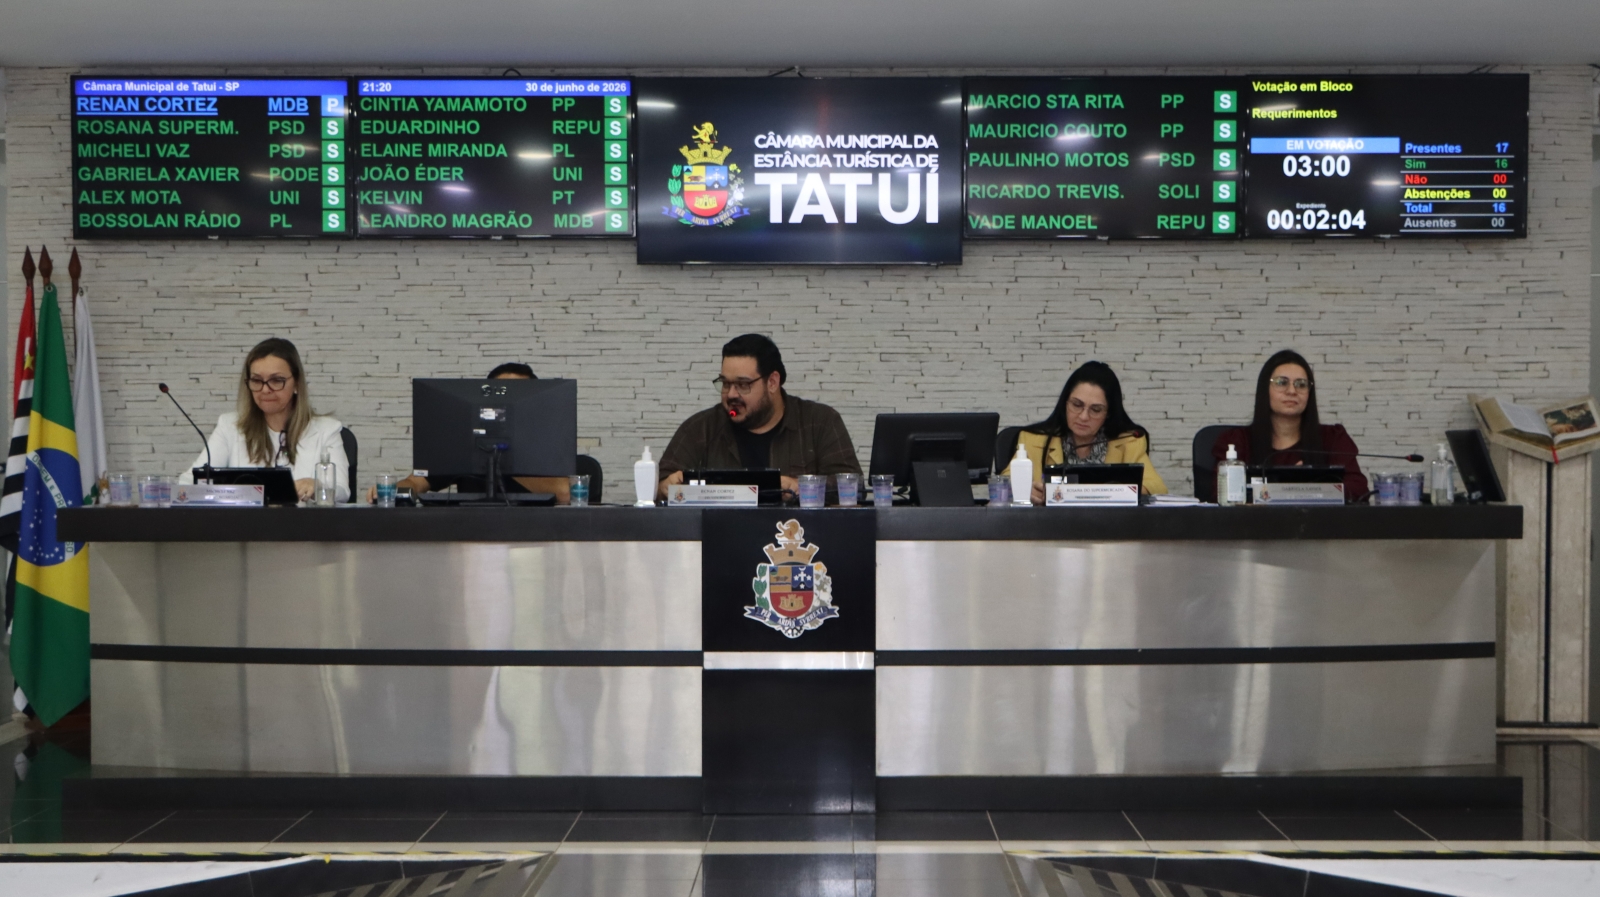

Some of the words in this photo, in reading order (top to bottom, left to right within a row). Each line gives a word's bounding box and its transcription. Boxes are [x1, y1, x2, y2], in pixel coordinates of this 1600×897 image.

[83, 81, 122, 91] Câmara
[125, 82, 174, 93] Municipal
[176, 82, 189, 91] de
[225, 82, 240, 91] SP
[363, 83, 392, 92] 21:20
[525, 83, 538, 92] 30
[540, 83, 553, 92] de
[555, 83, 585, 93] junho
[587, 83, 600, 92] de
[602, 83, 626, 92] 2026
[1253, 81, 1297, 93] Votação
[1320, 81, 1353, 91] Bloco
[77, 97, 139, 111] RENAN
[145, 97, 217, 111] CORTEZ
[268, 98, 308, 111] MDB
[328, 99, 338, 110] P
[360, 97, 419, 111] CINTIA
[424, 97, 527, 111] YAMAMOTO
[552, 98, 575, 111] PP
[610, 98, 621, 113] S
[970, 95, 1040, 109] MARCIO
[1046, 95, 1079, 109] STA
[1085, 95, 1124, 109] RITA
[1161, 95, 1184, 108] PP
[1219, 94, 1231, 109] S
[1252, 109, 1337, 120] Requerimentos
[78, 120, 153, 134] ROSANA
[158, 120, 239, 134] SUPERM.
[269, 120, 305, 134] PSD
[327, 121, 338, 135] S
[360, 120, 480, 134] EDUARDINHO
[553, 121, 600, 134] REPU
[610, 121, 621, 136] S
[969, 124, 1058, 138] MAURICIO
[1064, 124, 1127, 138] COUTO
[1161, 124, 1183, 138] PP
[1219, 123, 1231, 138] S
[754, 132, 823, 149] CÂMARA
[827, 135, 913, 149] MUNICIPAL
[914, 135, 938, 148] DA
[1287, 140, 1305, 150] EM
[1307, 138, 1364, 151] VOTAÇÃO
[78, 144, 150, 158] MICHELI
[156, 144, 190, 158] VAZ
[269, 144, 305, 158] PSD
[327, 144, 339, 158] S
[360, 144, 422, 158] ELAINE
[428, 144, 508, 158] MIRANDA
[553, 144, 574, 157] PL
[610, 143, 621, 158] S
[1405, 143, 1461, 155] Presentes
[1496, 143, 1509, 153] 17
[754, 151, 832, 168] ESTÂNCIA
[834, 151, 914, 168] TURÍSTICA
[918, 154, 938, 167] DE
[969, 153, 1059, 167] PAULINHO
[1065, 153, 1129, 167] MOTOS
[1159, 153, 1195, 167] PSD
[1219, 152, 1230, 167] S
[1283, 155, 1351, 177] 03:00
[1405, 159, 1426, 169] Sim
[1496, 159, 1508, 168] 16
[78, 167, 170, 181] GABRIELA
[175, 167, 240, 181] XAVIER
[269, 168, 319, 181] PODE
[328, 167, 339, 182] S
[360, 164, 409, 181] JOÃO
[415, 163, 464, 181] ÉDER
[553, 167, 582, 181] UNI
[610, 167, 622, 182] S
[1405, 174, 1427, 184] Não
[1493, 174, 1507, 184] 00
[79, 191, 124, 205] ALEX
[131, 191, 181, 205] MOTA
[270, 191, 299, 205] UNI
[328, 190, 339, 205] S
[360, 191, 422, 205] KELVIN
[553, 191, 574, 204] PT
[610, 190, 622, 205] S
[754, 168, 939, 224] TATUÍ
[969, 184, 1051, 199] RICARDO
[1057, 184, 1124, 199] TREVIS.
[1158, 184, 1199, 199] SOLI
[1219, 184, 1230, 199] S
[1404, 188, 1470, 201] Abstenções
[1493, 189, 1506, 199] 00
[1405, 204, 1432, 213] Total
[1492, 204, 1506, 213] 16
[79, 214, 178, 228] BOSSOLAN
[184, 210, 241, 228] RÁDIO
[270, 215, 292, 228] PL
[328, 214, 339, 229] S
[360, 214, 446, 228] LEANDRO
[452, 210, 532, 228] MAGRÃO
[554, 214, 593, 228] MDB
[610, 214, 622, 229] S
[969, 215, 1015, 229] VADE
[1022, 215, 1097, 229] MANOEL
[1157, 215, 1205, 229] REPU
[1218, 215, 1230, 230] S
[1267, 210, 1366, 230] 00:02:04
[1404, 218, 1456, 228] Ausentes
[1491, 218, 1505, 228] 00
[760, 608, 772, 619] PER
